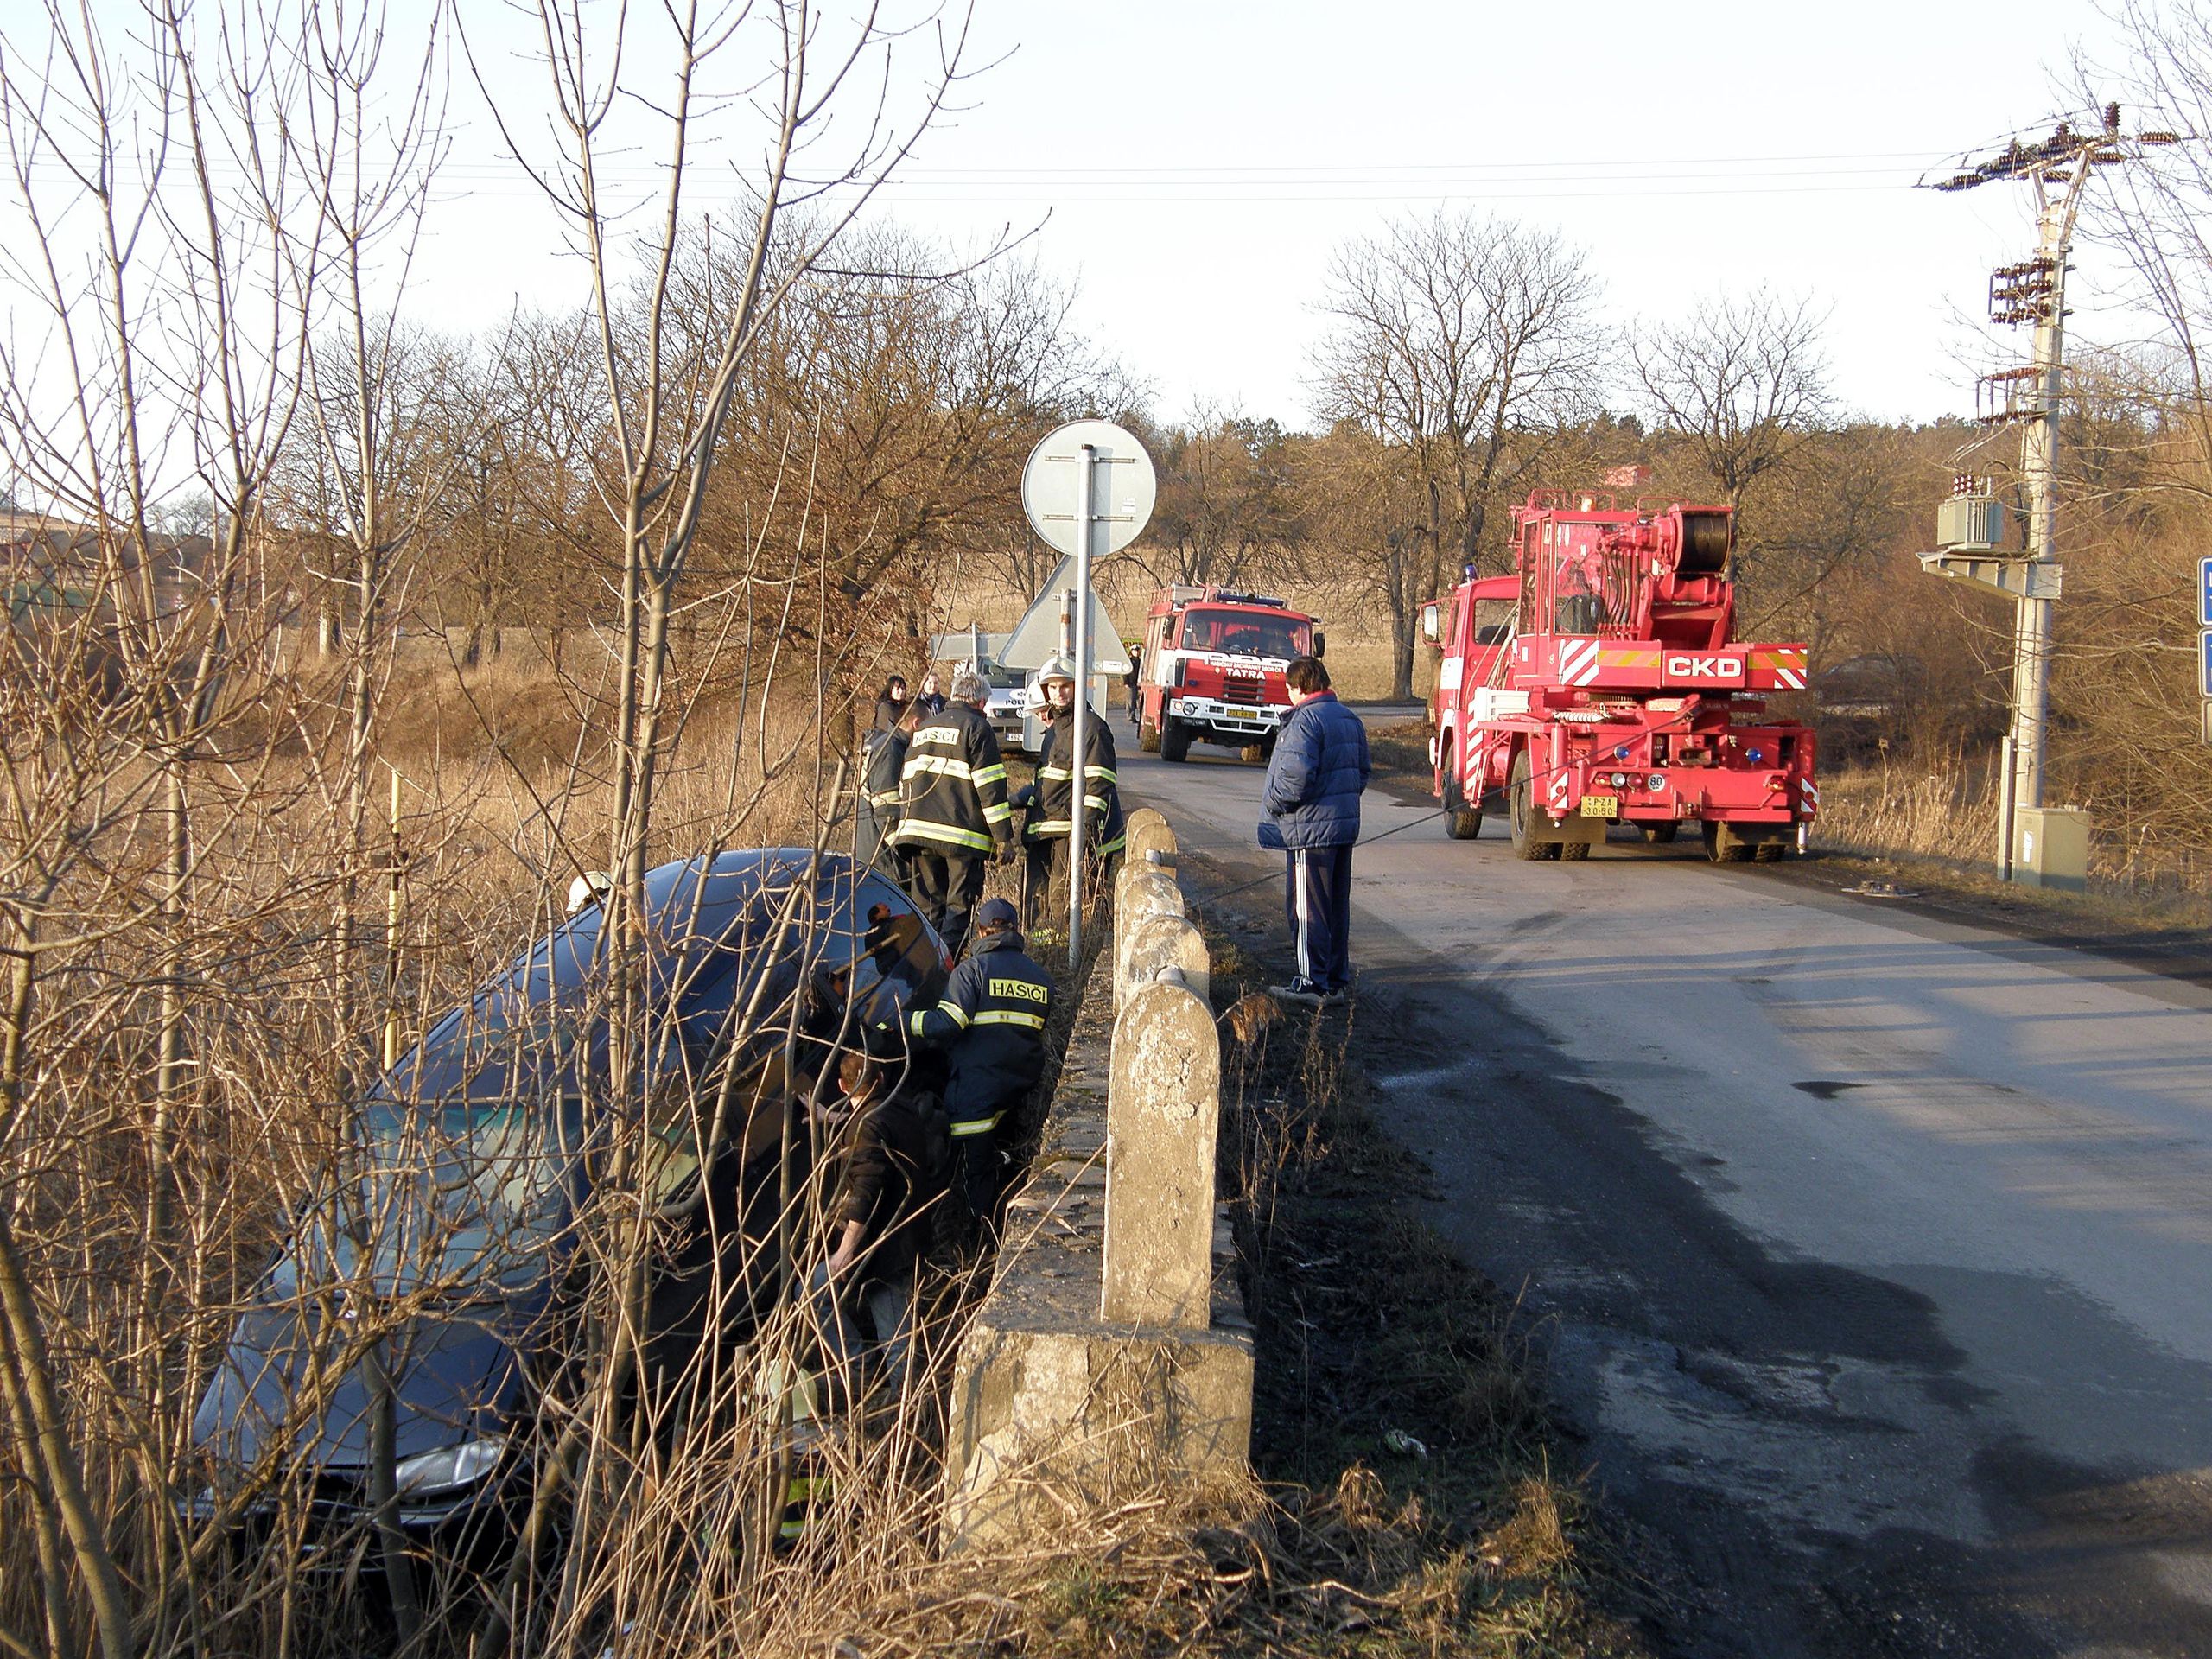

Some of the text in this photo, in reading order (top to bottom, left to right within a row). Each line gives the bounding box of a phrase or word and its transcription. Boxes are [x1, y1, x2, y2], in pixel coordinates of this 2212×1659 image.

[1226, 668, 1266, 679] TATRA
[1649, 777, 1662, 785] 80
[992, 982, 1046, 1002] HASIČI
